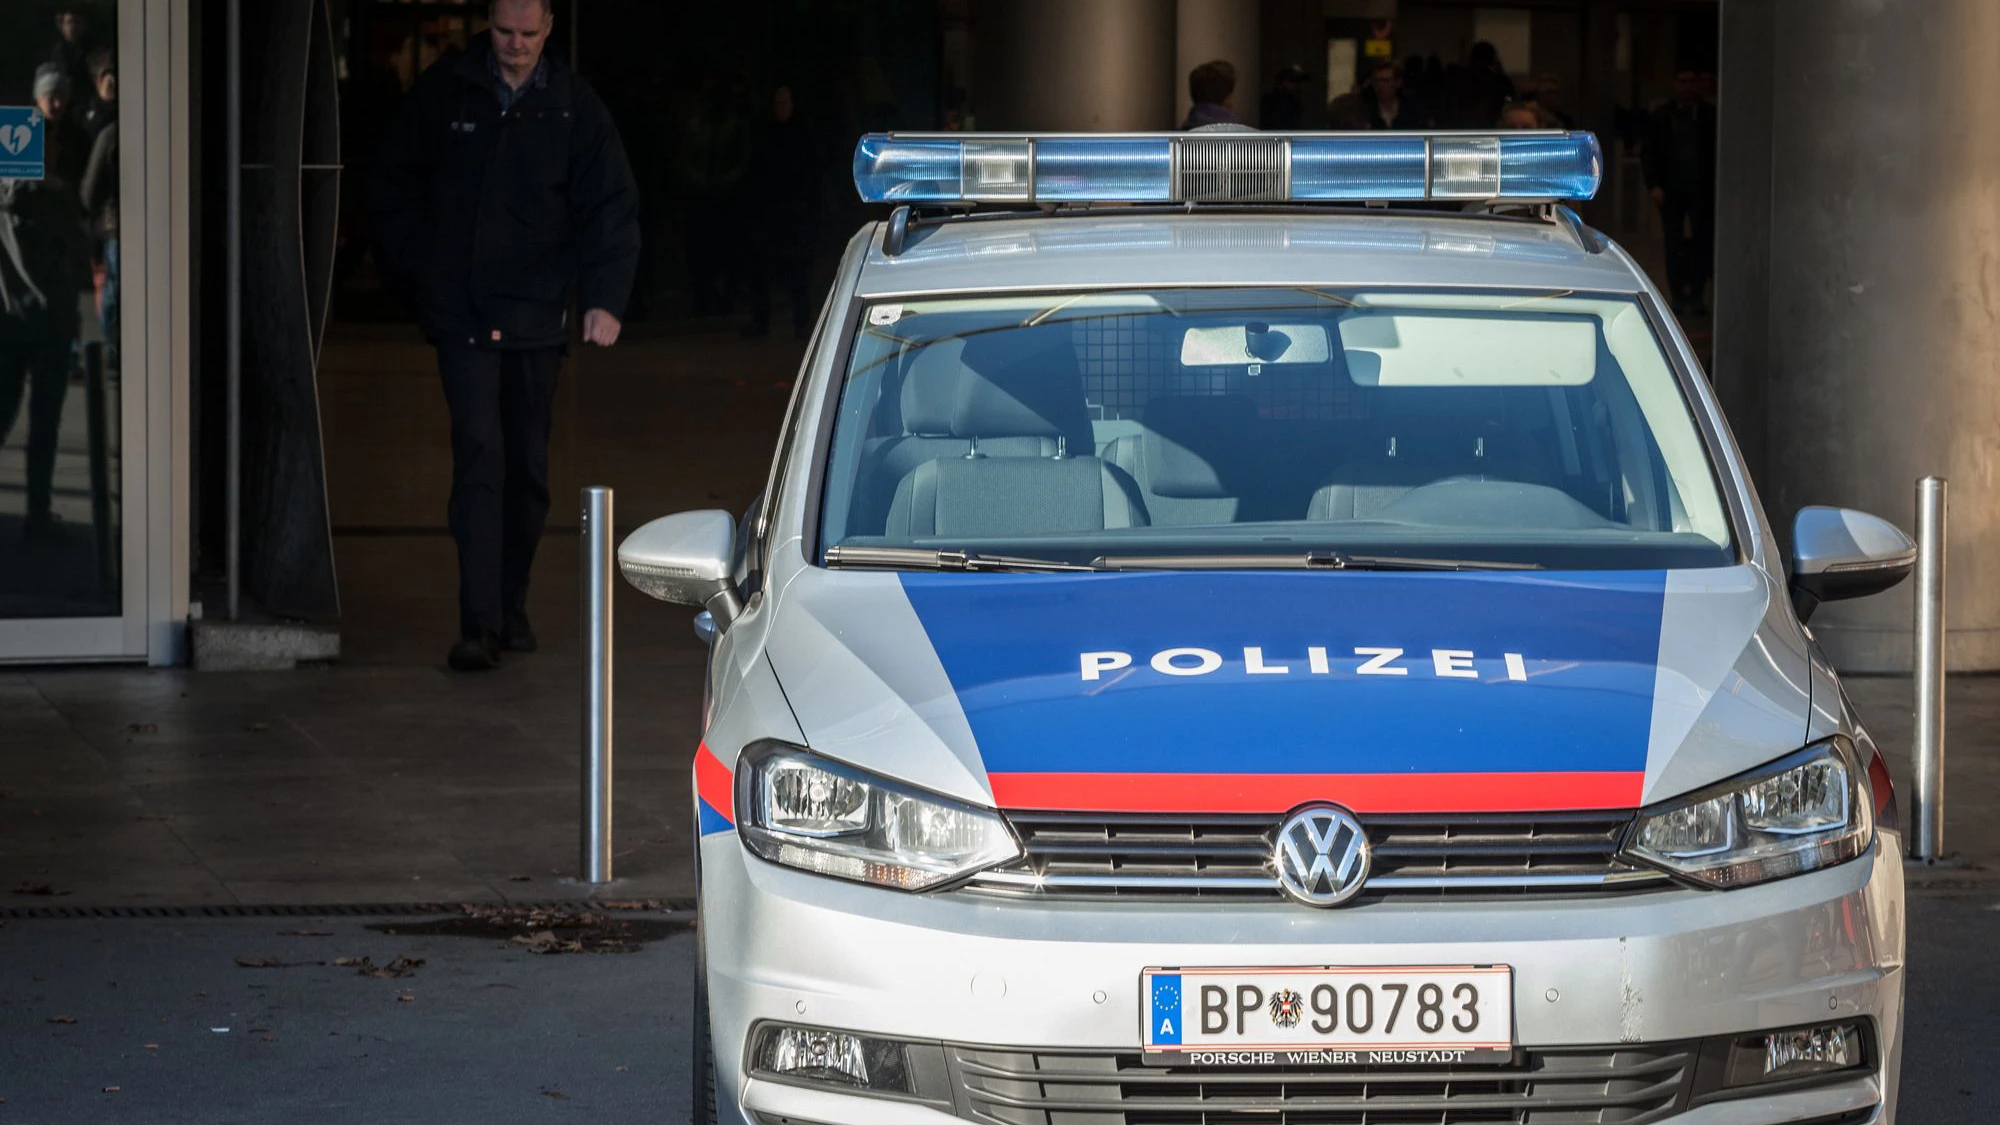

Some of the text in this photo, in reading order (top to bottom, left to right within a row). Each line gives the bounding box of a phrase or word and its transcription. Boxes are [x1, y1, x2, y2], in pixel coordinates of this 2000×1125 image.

[1080, 646, 1527, 682] POLIZEI
[1279, 810, 1367, 901] VW
[1160, 1018, 1175, 1036] A
[1200, 982, 1480, 1036] BP 90783
[1189, 1050, 1466, 1066] PORSCHE WIENER NEUSTADT
